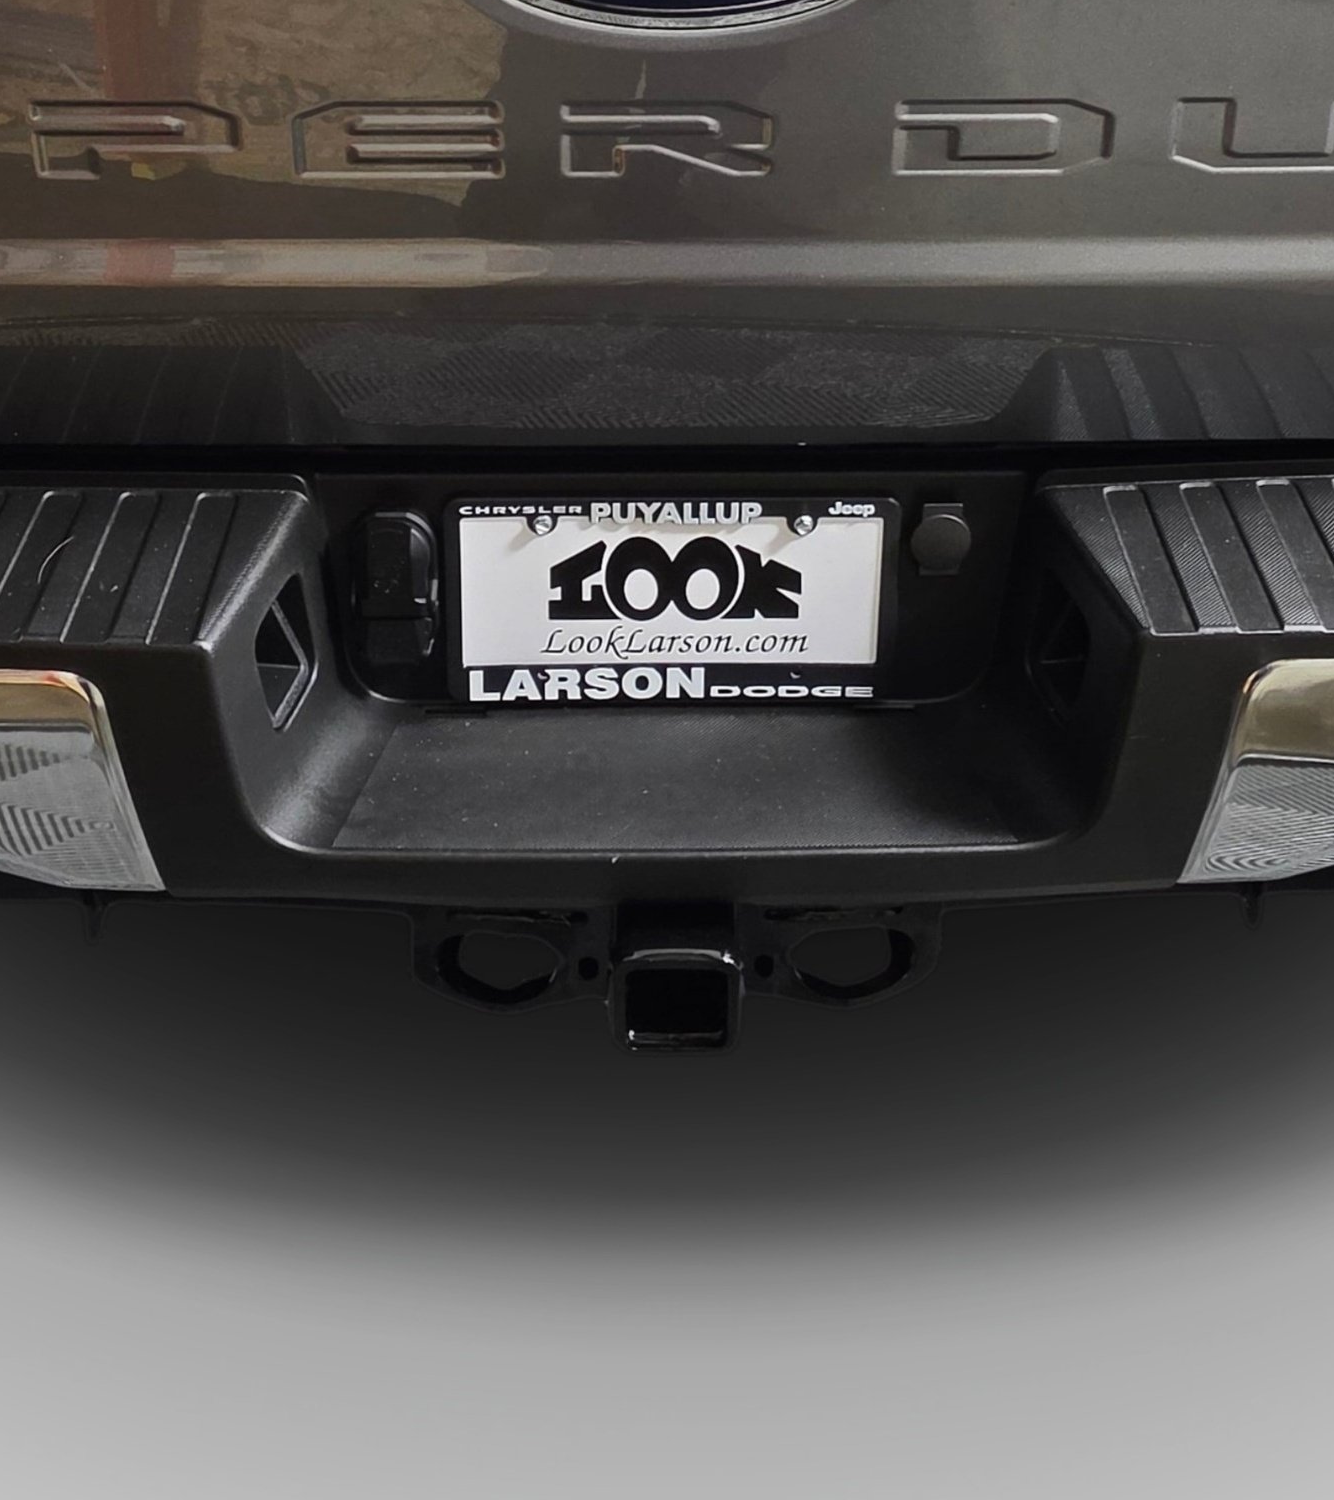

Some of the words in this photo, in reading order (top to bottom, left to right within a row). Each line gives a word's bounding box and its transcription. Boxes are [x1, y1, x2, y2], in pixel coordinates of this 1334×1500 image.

[458, 504, 583, 515] CHRYSLER
[589, 501, 763, 525] PUYALLUP
[828, 501, 876, 518] Jeep
[548, 536, 803, 621] LOOK
[540, 625, 810, 657] LookLarson.com
[469, 667, 705, 701] LARSON
[709, 684, 875, 699] DODGE
